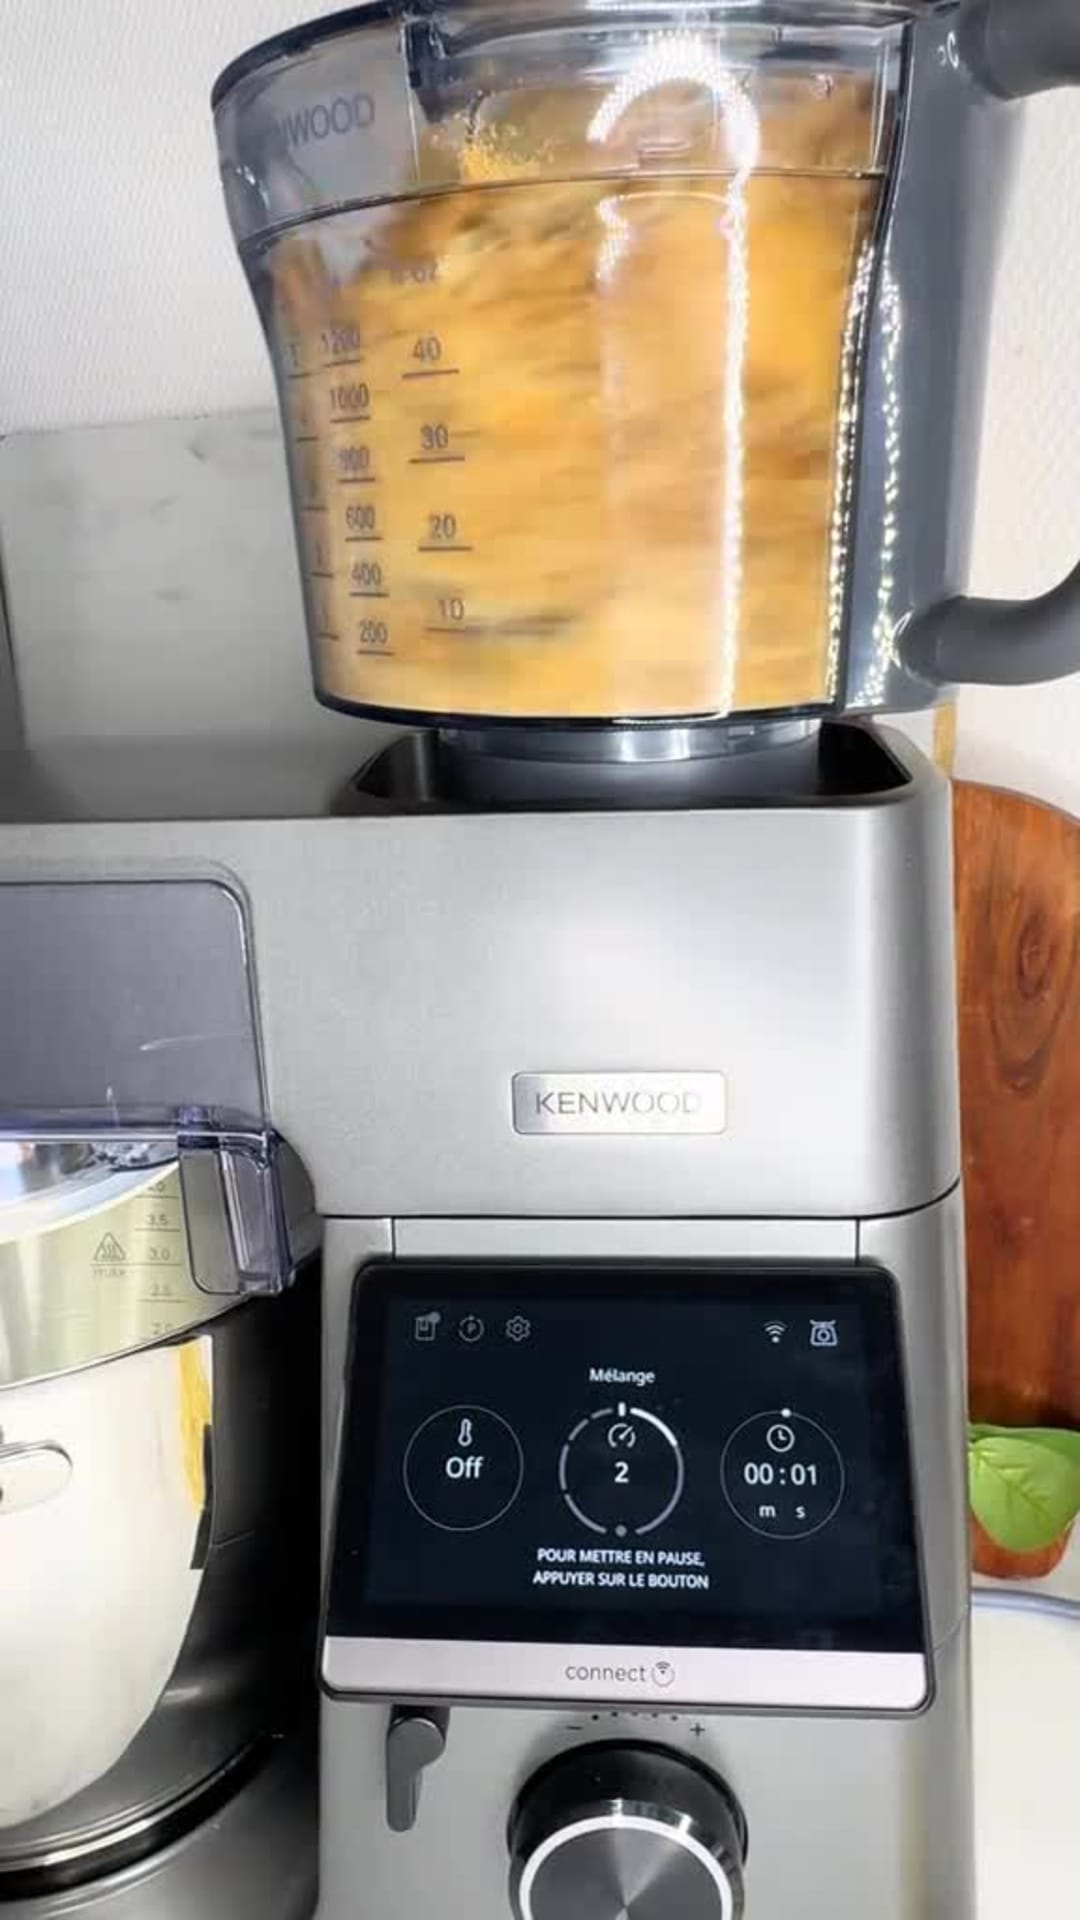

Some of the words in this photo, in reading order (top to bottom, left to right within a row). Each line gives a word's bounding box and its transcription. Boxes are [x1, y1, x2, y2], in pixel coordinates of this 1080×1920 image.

[412, 336, 442, 363] 40
[329, 382, 369, 410] 1000
[420, 423, 449, 450] 30
[346, 506, 376, 530] 600
[430, 514, 457, 539] 20
[351, 563, 382, 586] 400
[438, 597, 465, 621] 10
[359, 621, 388, 644] 200
[535, 1091, 703, 1115] KENWOOD
[589, 1367, 656, 1387] Mélange
[446, 1456, 484, 1479] Off
[614, 1461, 630, 1484] 2
[758, 1505, 776, 1518] m
[795, 1506, 806, 1519] s
[537, 1548, 577, 1563] POUR
[579, 1550, 633, 1565] METTRE
[635, 1551, 655, 1565] EN
[657, 1551, 706, 1567] PAUSE,
[532, 1570, 595, 1586] APPUYER
[597, 1573, 626, 1587] SUR
[628, 1574, 646, 1588] LE
[648, 1574, 710, 1590] BOUTON
[565, 1665, 647, 1682] connect
